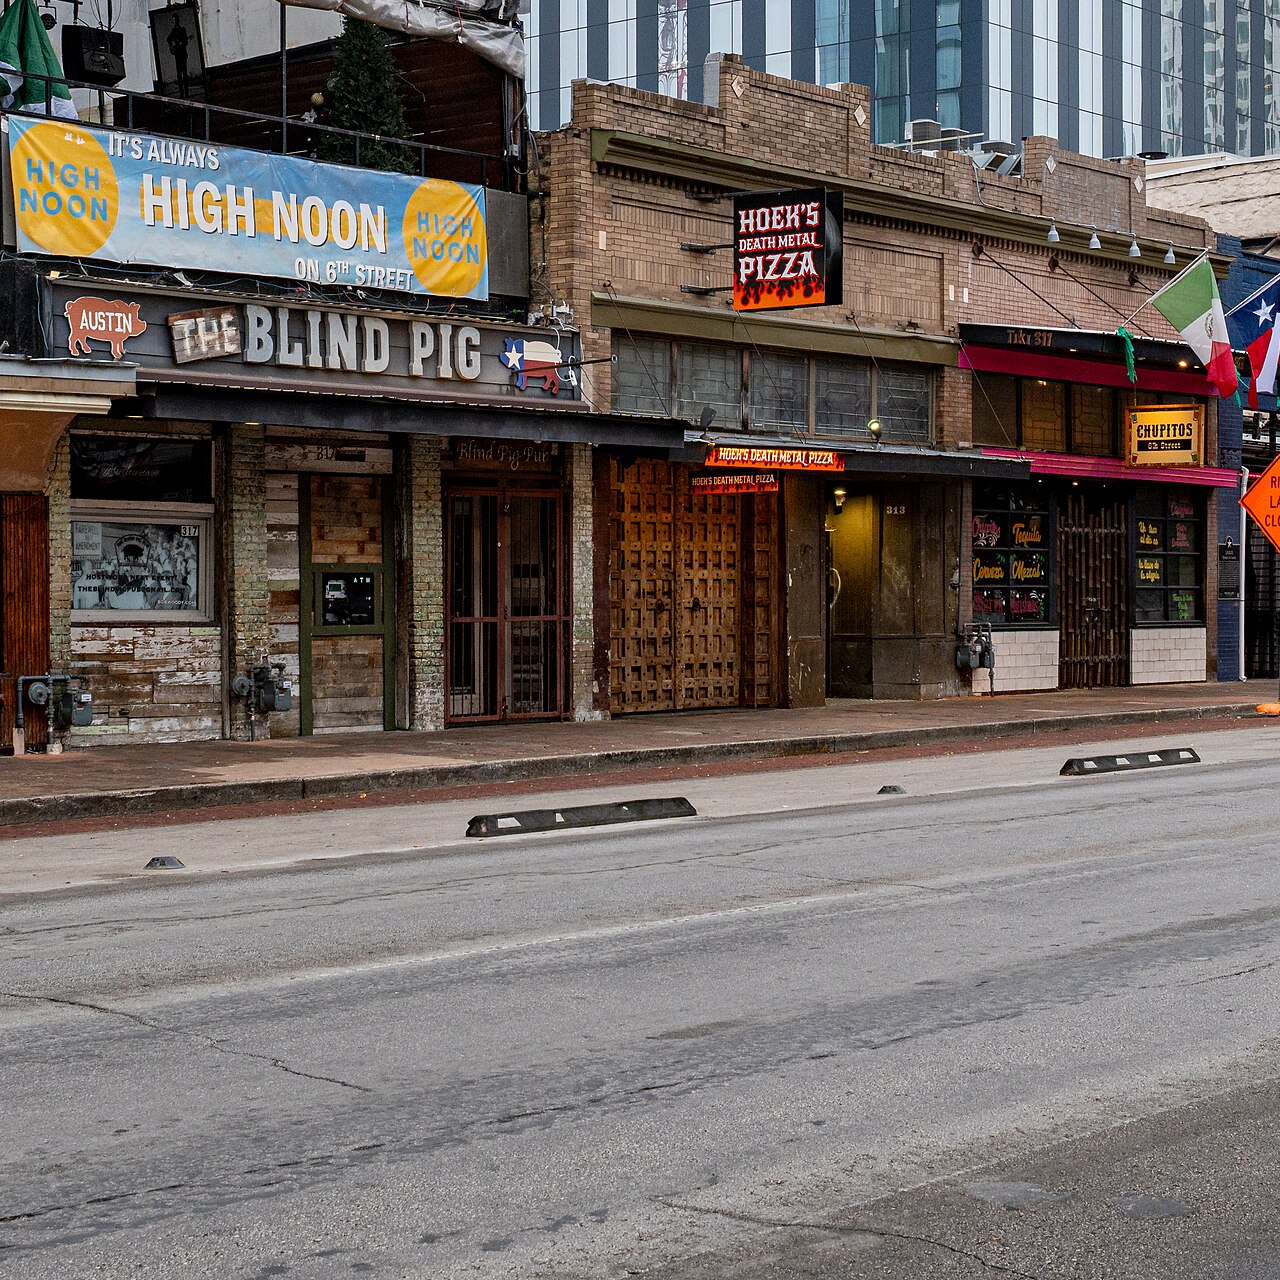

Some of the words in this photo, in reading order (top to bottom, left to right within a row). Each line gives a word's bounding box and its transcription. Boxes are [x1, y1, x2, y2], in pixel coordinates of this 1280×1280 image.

[108, 133, 144, 160] IT'S
[147, 140, 220, 170] ALWAYS
[26, 157, 100, 191] HIGH
[19, 187, 108, 221] NOON
[142, 173, 256, 238] HIGH
[272, 190, 387, 254] NOON
[417, 211, 473, 238] HIGH
[738, 202, 821, 234] HOEK'S
[412, 237, 480, 265] NOON
[738, 235, 776, 253] DEATH
[777, 231, 823, 250] METAL
[295, 257, 320, 281] ON
[326, 260, 349, 283] 6TH
[355, 263, 414, 291] STREET
[738, 250, 820, 285] PIZZA
[80, 309, 133, 334] AUSTIN
[182, 313, 238, 356] THE
[243, 304, 389, 373] BLIND
[408, 321, 482, 380] PIG
[1136, 423, 1193, 439] CHUPITOS
[317, 447, 335, 460] 317
[456, 441, 493, 462] Blind
[497, 445, 520, 470] Pig
[523, 447, 550, 463] Pub
[719, 447, 749, 461] HOEK'S
[750, 449, 778, 462] DEATH
[778, 450, 809, 466] METAL
[809, 451, 834, 464] PIZZA
[713, 475, 733, 485] DEATH
[733, 475, 756, 486] METAL
[755, 474, 775, 483] PIZZA
[886, 505, 905, 514] 313
[182, 525, 198, 535] 317
[1012, 523, 1041, 545] Tequila
[973, 558, 1004, 581] Cerveza
[1011, 560, 1041, 581] Mezcal
